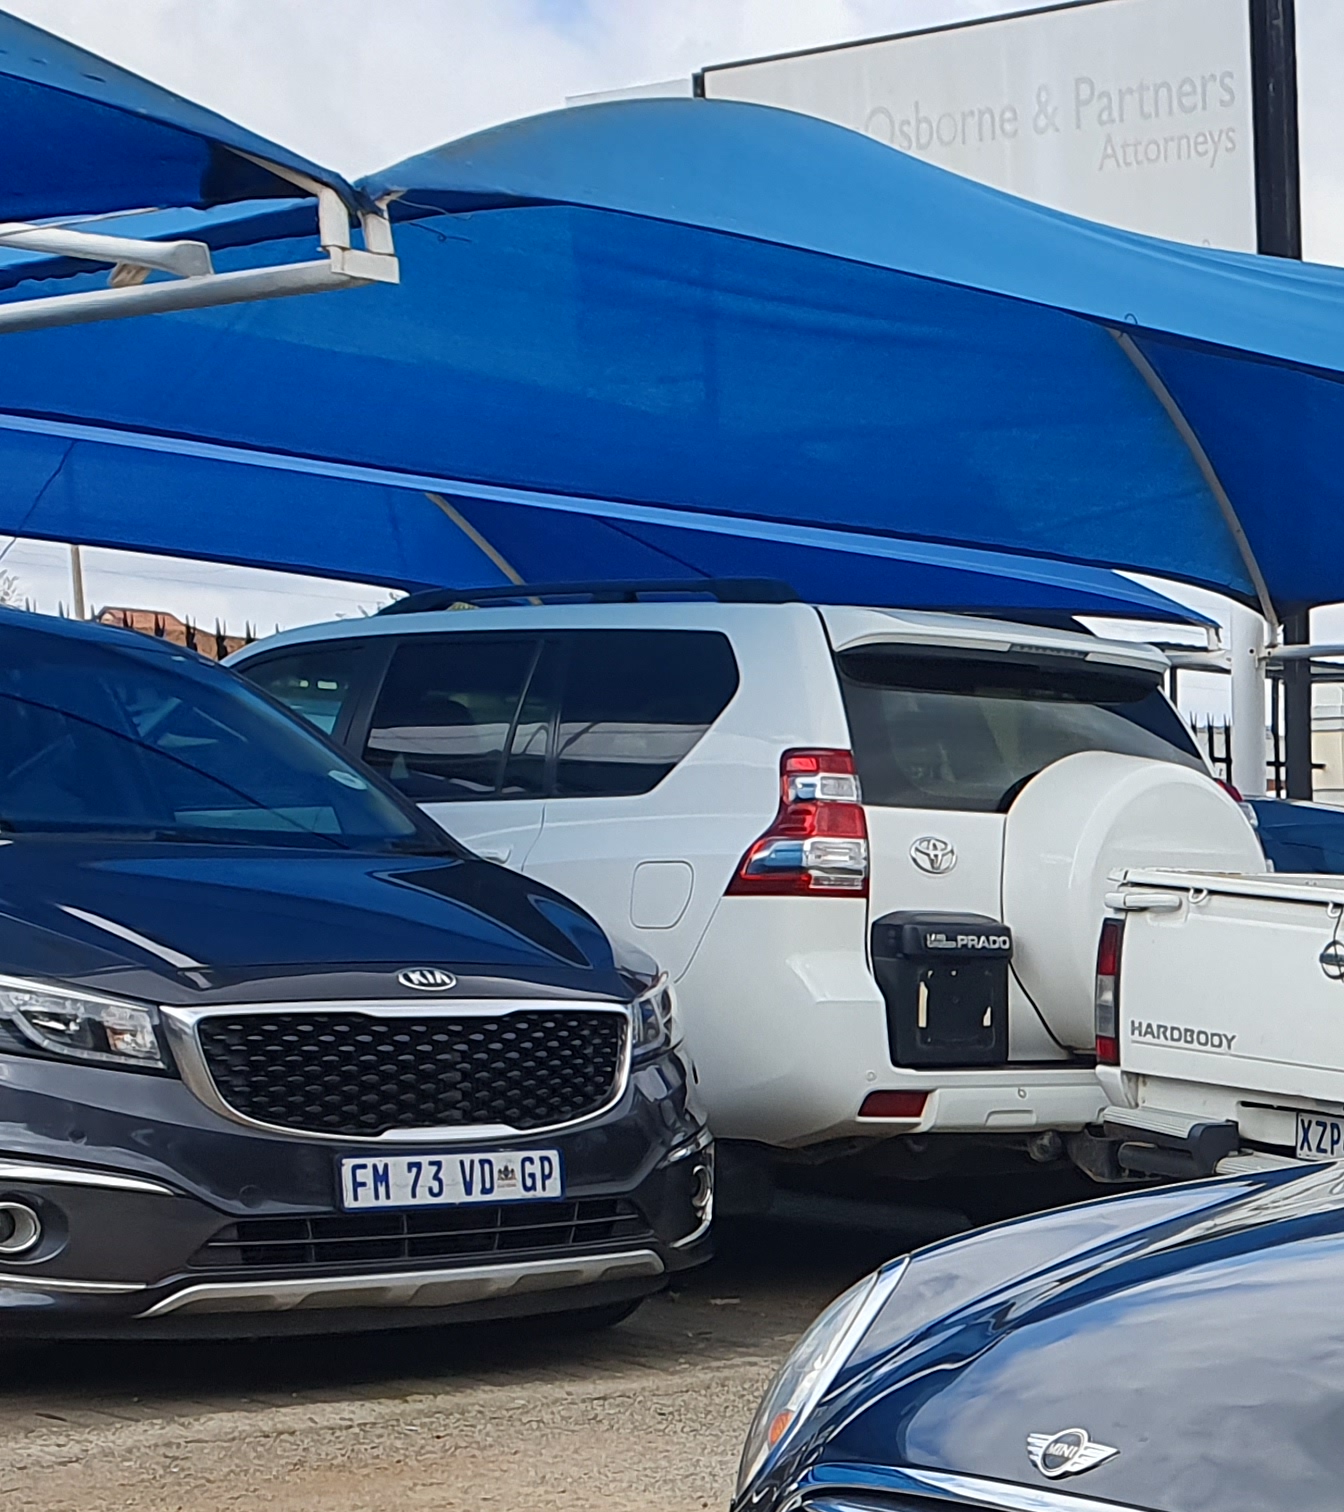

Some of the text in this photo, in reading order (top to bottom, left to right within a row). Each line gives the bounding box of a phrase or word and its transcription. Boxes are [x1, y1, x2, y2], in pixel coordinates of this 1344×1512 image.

[865, 70, 1236, 151] Osborne & Partners
[1099, 126, 1237, 171] Attorneys
[956, 934, 1010, 950] PRADO
[407, 970, 451, 985] KIA
[1130, 1019, 1237, 1051] HARDBODY
[350, 1155, 554, 1202] FM 73 VD GP
[1045, 1442, 1079, 1459] MINI
